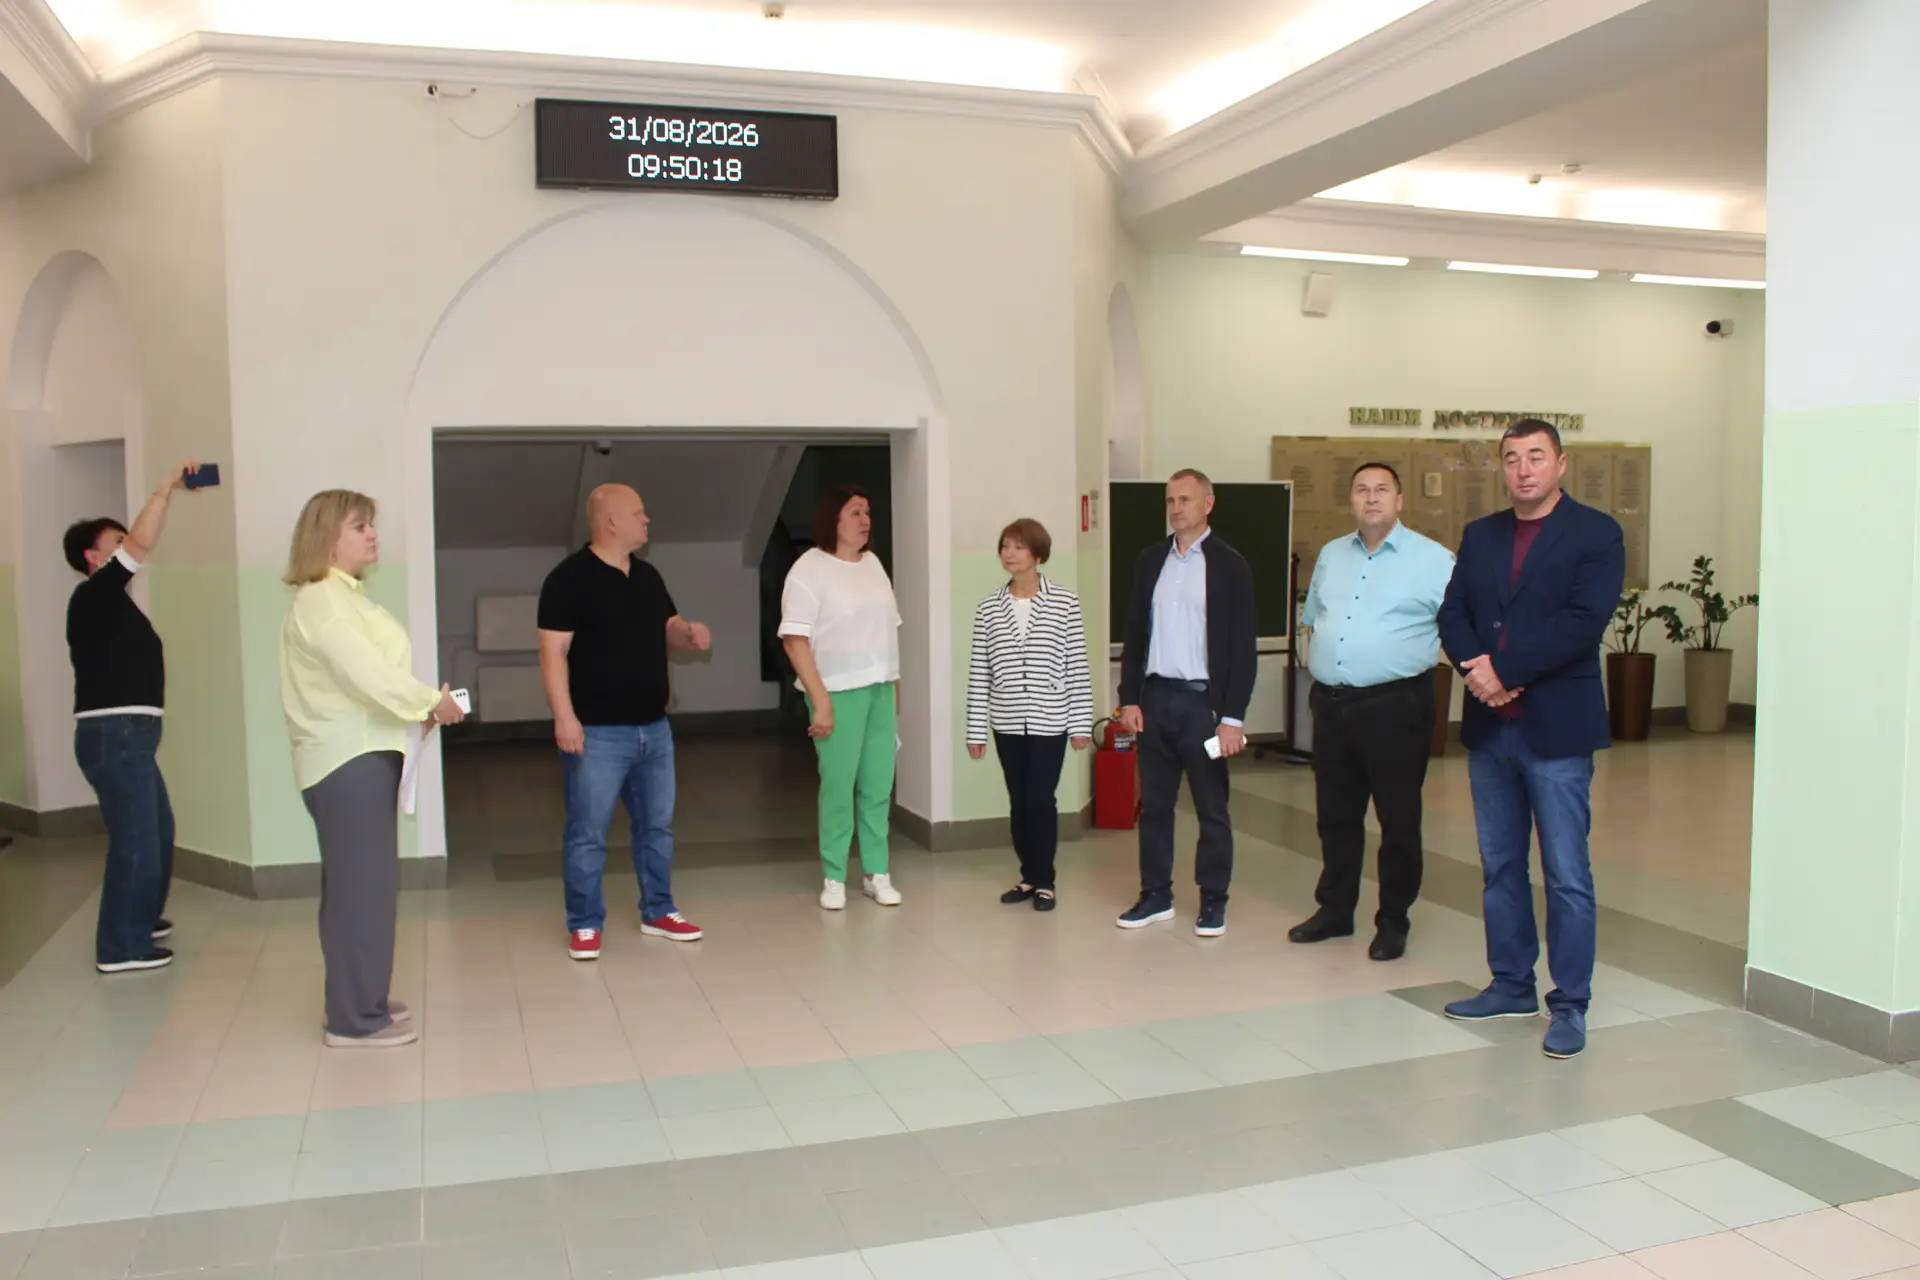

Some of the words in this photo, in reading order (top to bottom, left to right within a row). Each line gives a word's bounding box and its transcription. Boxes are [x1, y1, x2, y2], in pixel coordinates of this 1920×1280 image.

[609, 116, 759, 147] 31/08/2026
[628, 154, 742, 182] 09:50:18
[1349, 408, 1421, 426] НАШИ
